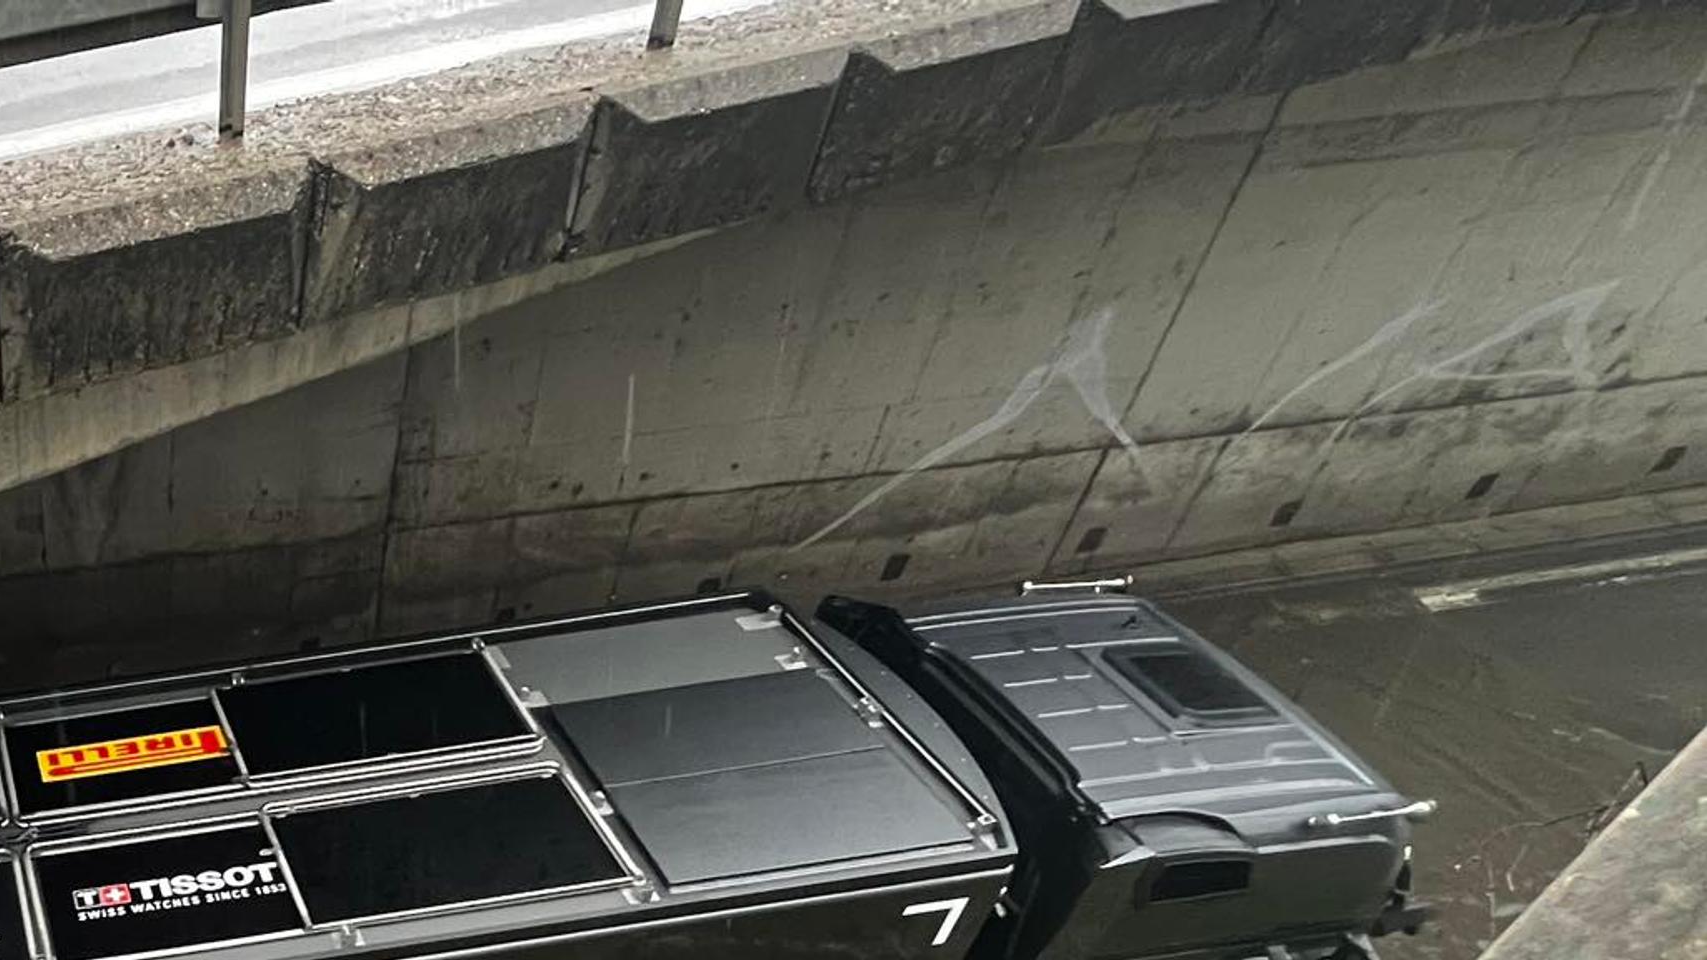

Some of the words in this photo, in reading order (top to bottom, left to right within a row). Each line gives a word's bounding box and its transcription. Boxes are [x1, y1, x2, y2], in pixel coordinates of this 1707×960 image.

[47, 730, 226, 777] PIRELLI
[129, 861, 279, 901] TISSOT
[76, 905, 127, 922] SWISS
[131, 895, 202, 914] WATCHES
[205, 889, 251, 904] SINCE
[255, 882, 288, 896] 1853
